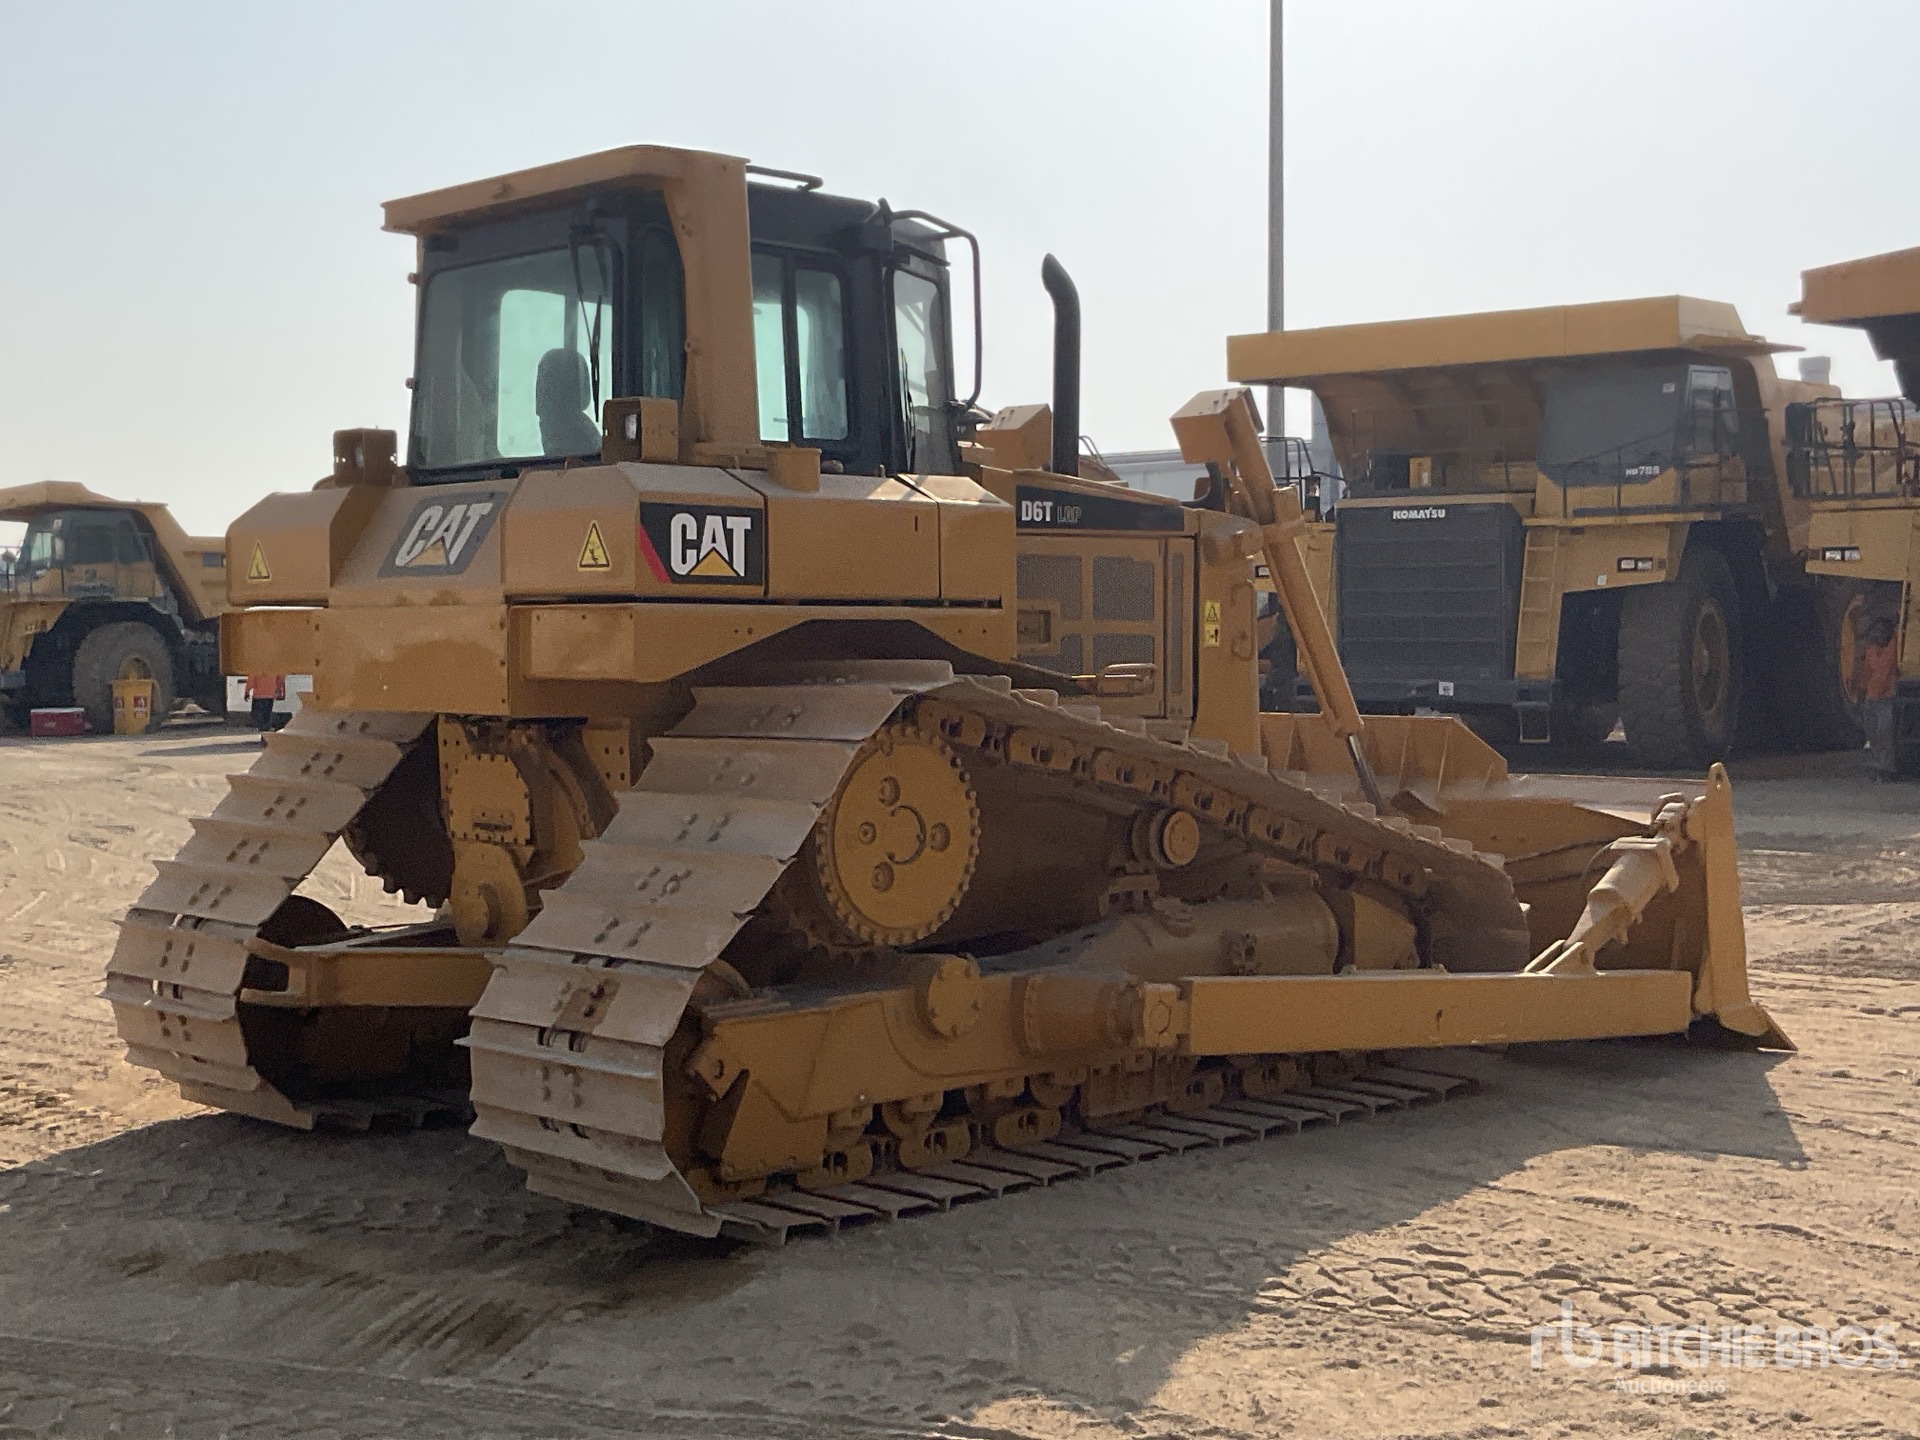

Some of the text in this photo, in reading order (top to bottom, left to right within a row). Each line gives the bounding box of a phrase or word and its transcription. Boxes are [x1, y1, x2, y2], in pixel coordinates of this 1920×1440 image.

[1021, 500, 1053, 522] D6T
[1392, 506, 1446, 519] KOMATSU
[395, 502, 493, 567] CAT
[670, 512, 752, 577] CAT
